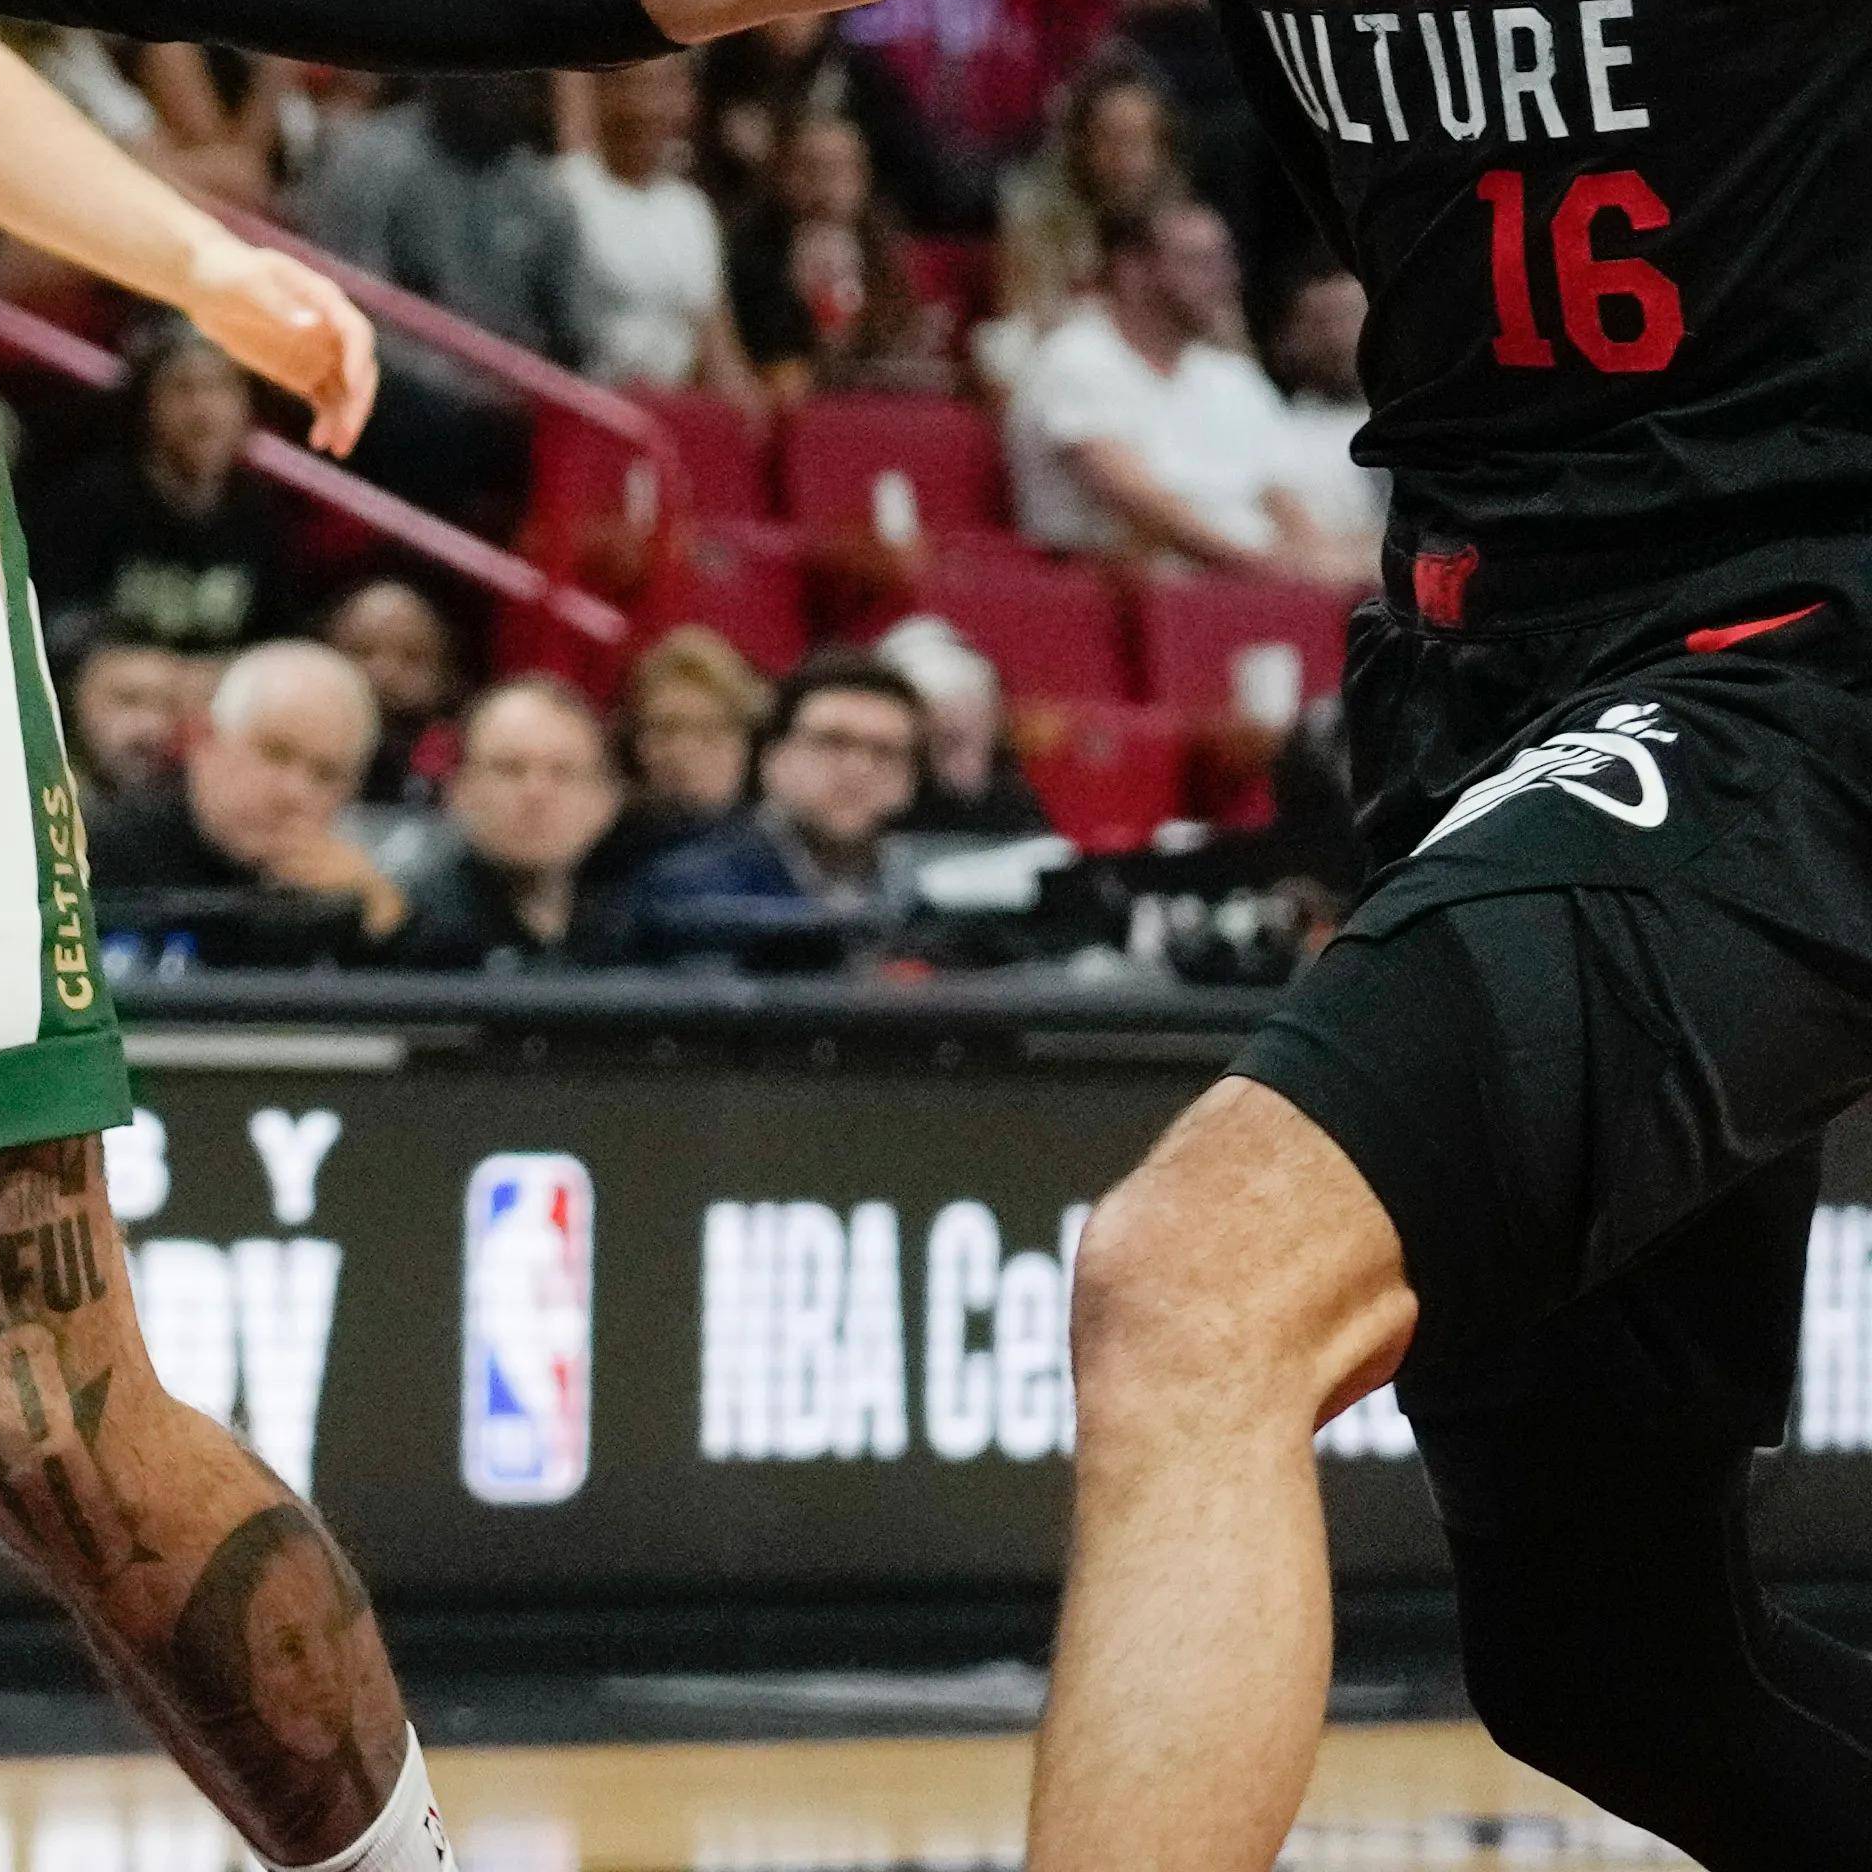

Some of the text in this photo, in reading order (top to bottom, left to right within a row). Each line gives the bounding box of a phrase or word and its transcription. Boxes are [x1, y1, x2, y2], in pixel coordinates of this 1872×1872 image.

[1475, 168, 1687, 374] 16
[42, 784, 94, 1011] CELTICS
[698, 1200, 909, 1461] NBA
